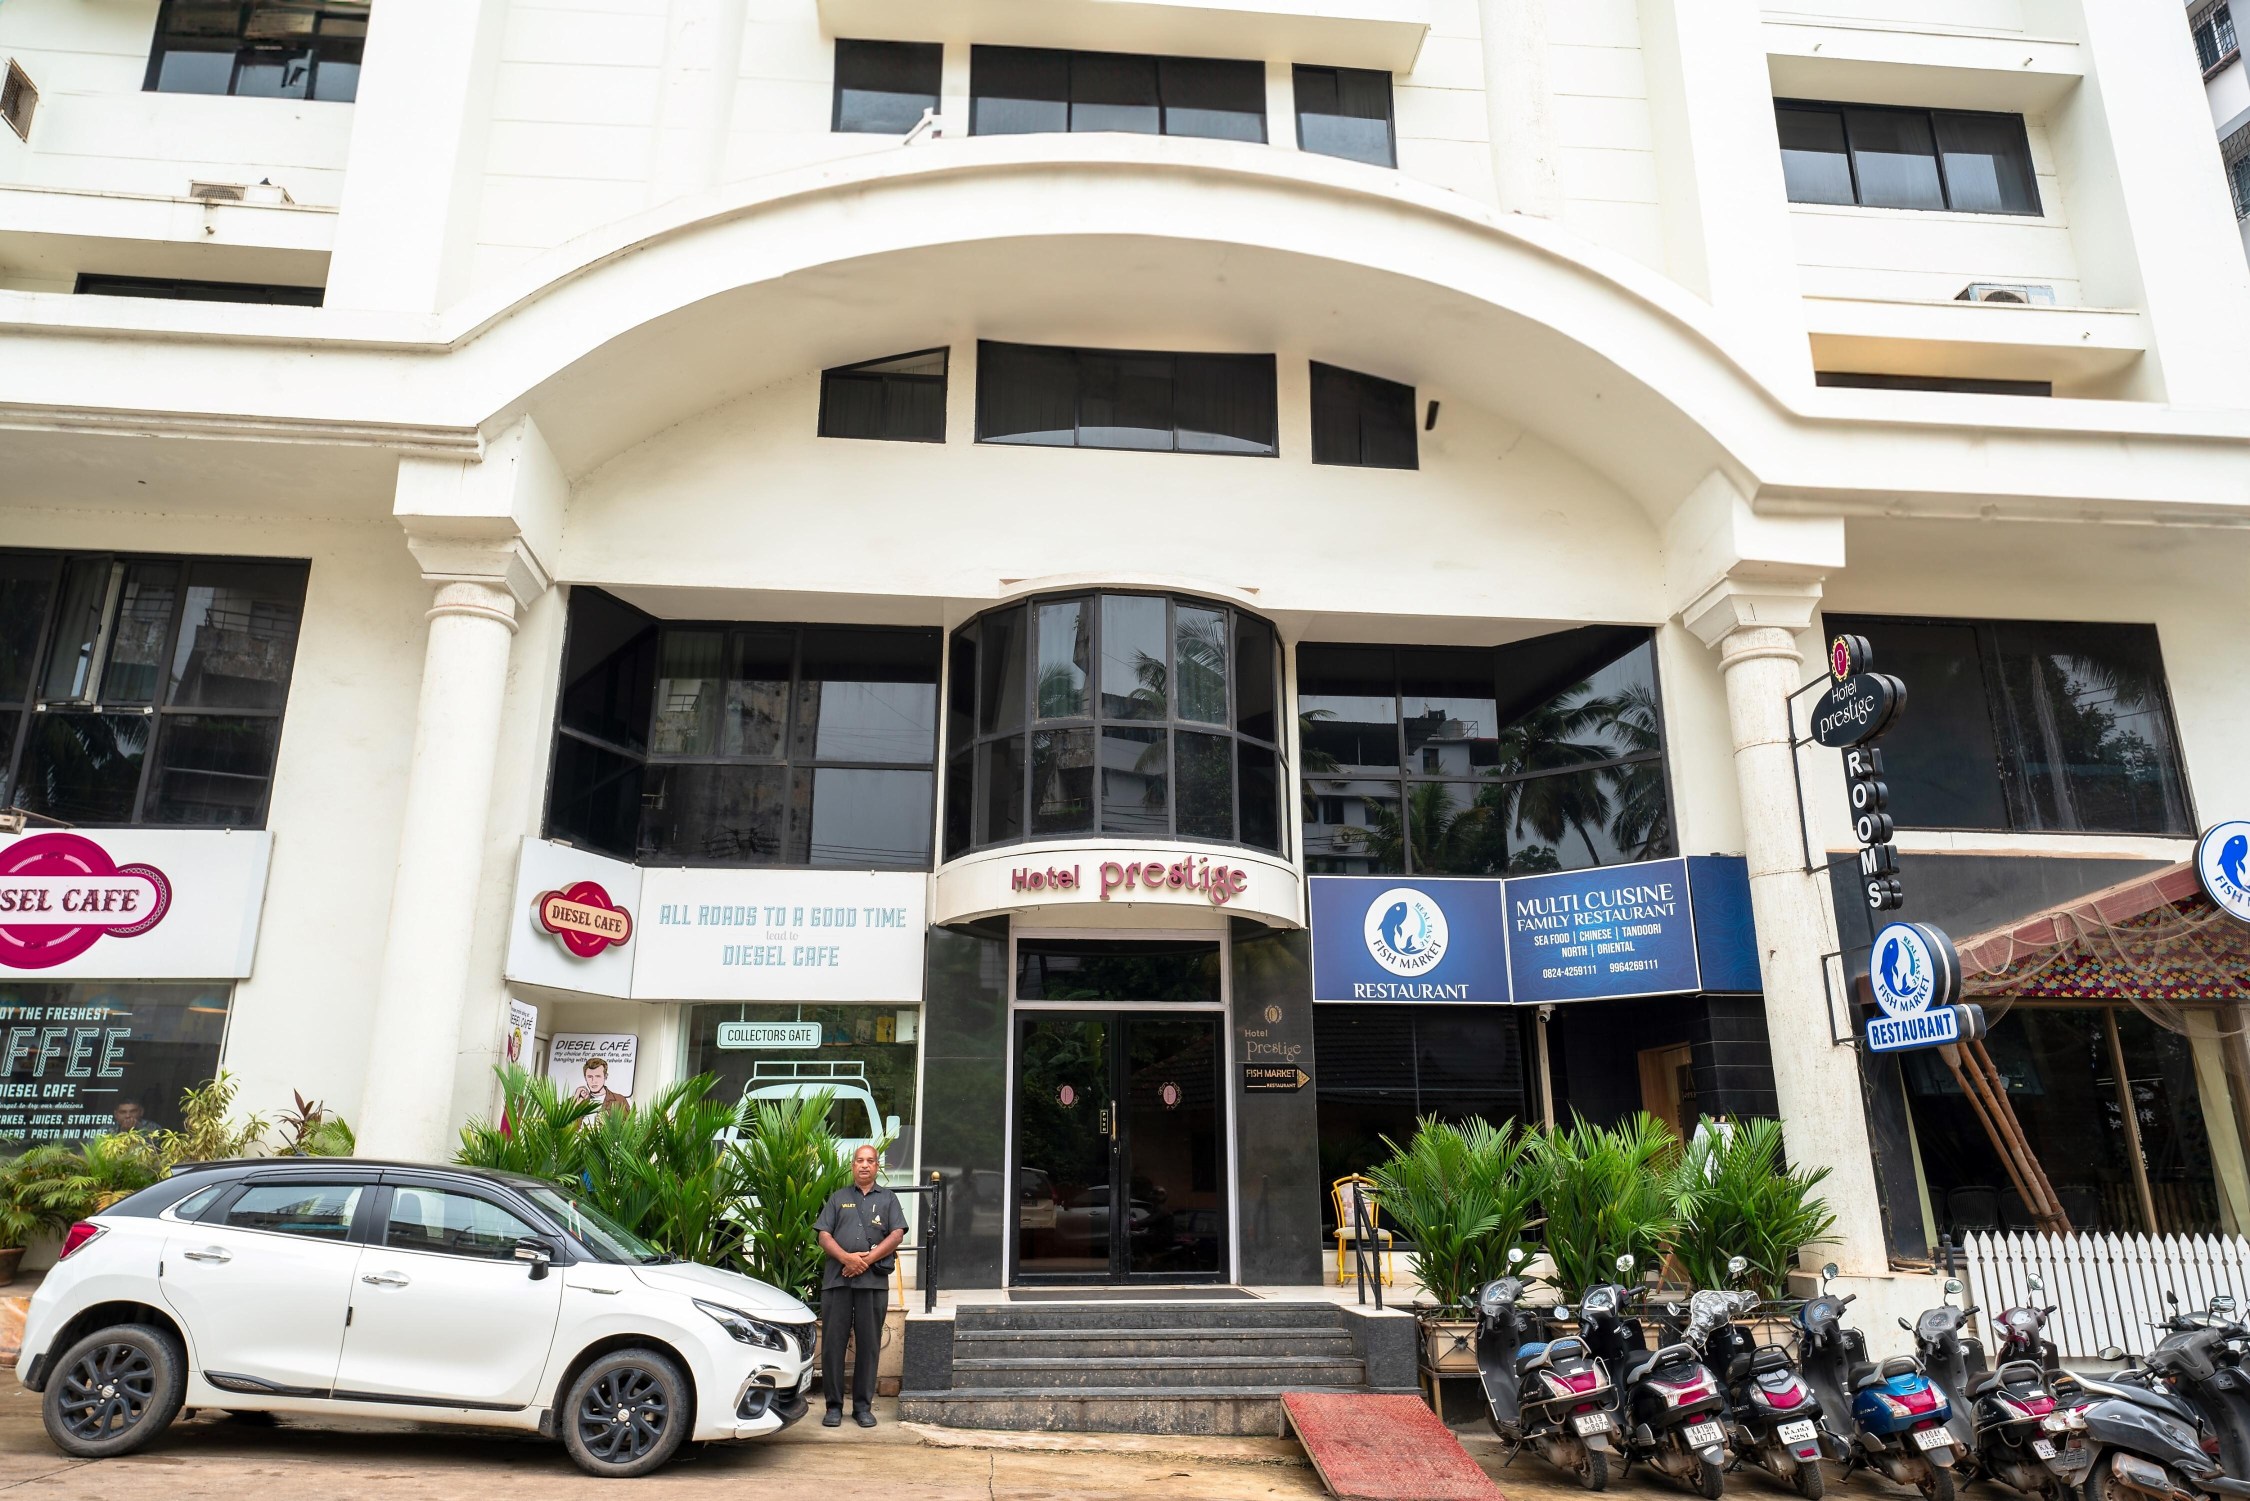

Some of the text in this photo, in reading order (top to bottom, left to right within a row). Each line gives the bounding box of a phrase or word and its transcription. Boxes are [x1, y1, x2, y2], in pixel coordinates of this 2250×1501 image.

[1831, 678, 1857, 704] Hotel
[1820, 695, 1875, 742] prestige
[1847, 750, 1882, 908] ROOMS
[1011, 855, 1248, 905] Hotel prestige
[2215, 875, 2243, 903] FISH
[0, 889, 140, 912] SEL CAFE
[1414, 902, 1431, 920] REAL
[1516, 883, 1674, 917] MULTI CUISINE
[551, 904, 623, 933] DIESEL CAFE
[659, 904, 907, 928] ALL ROADS TO A GOOD TIME
[1517, 902, 1677, 932] FAMILY RESTAURANT
[766, 930, 799, 941] lead to
[1421, 923, 1433, 948] TASTE
[1533, 923, 1662, 946] SEA FOOD CHINESE TANDOORI
[1903, 936, 1917, 955] REAL
[722, 944, 840, 966] DIESEL CAFE
[1373, 939, 1442, 969] FISH MARKET
[1561, 940, 1635, 958] NORTH ORIENTAL
[1353, 983, 1470, 999] RESTAURANT
[1878, 975, 1930, 1012] FISH MARKET
[0, 1007, 110, 1020] OY THE FRESHEST
[727, 1029, 812, 1042] COLLECTORS GATE
[1244, 1029, 1268, 1037] Hotel
[1871, 1013, 1952, 1046] RESTAURANT
[0, 1027, 131, 1077] FFEE
[555, 1039, 631, 1051] DIESEL CAFÉ
[1246, 1069, 1296, 1078] FISH MARKET
[43, 1084, 77, 1098] CAFE
[0, 1102, 18, 1111] orget
[0, 1115, 116, 1126] AKES, JUICES, STARTERS,
[31, 1129, 60, 1139] PASTA
[62, 1129, 81, 1139] AND
